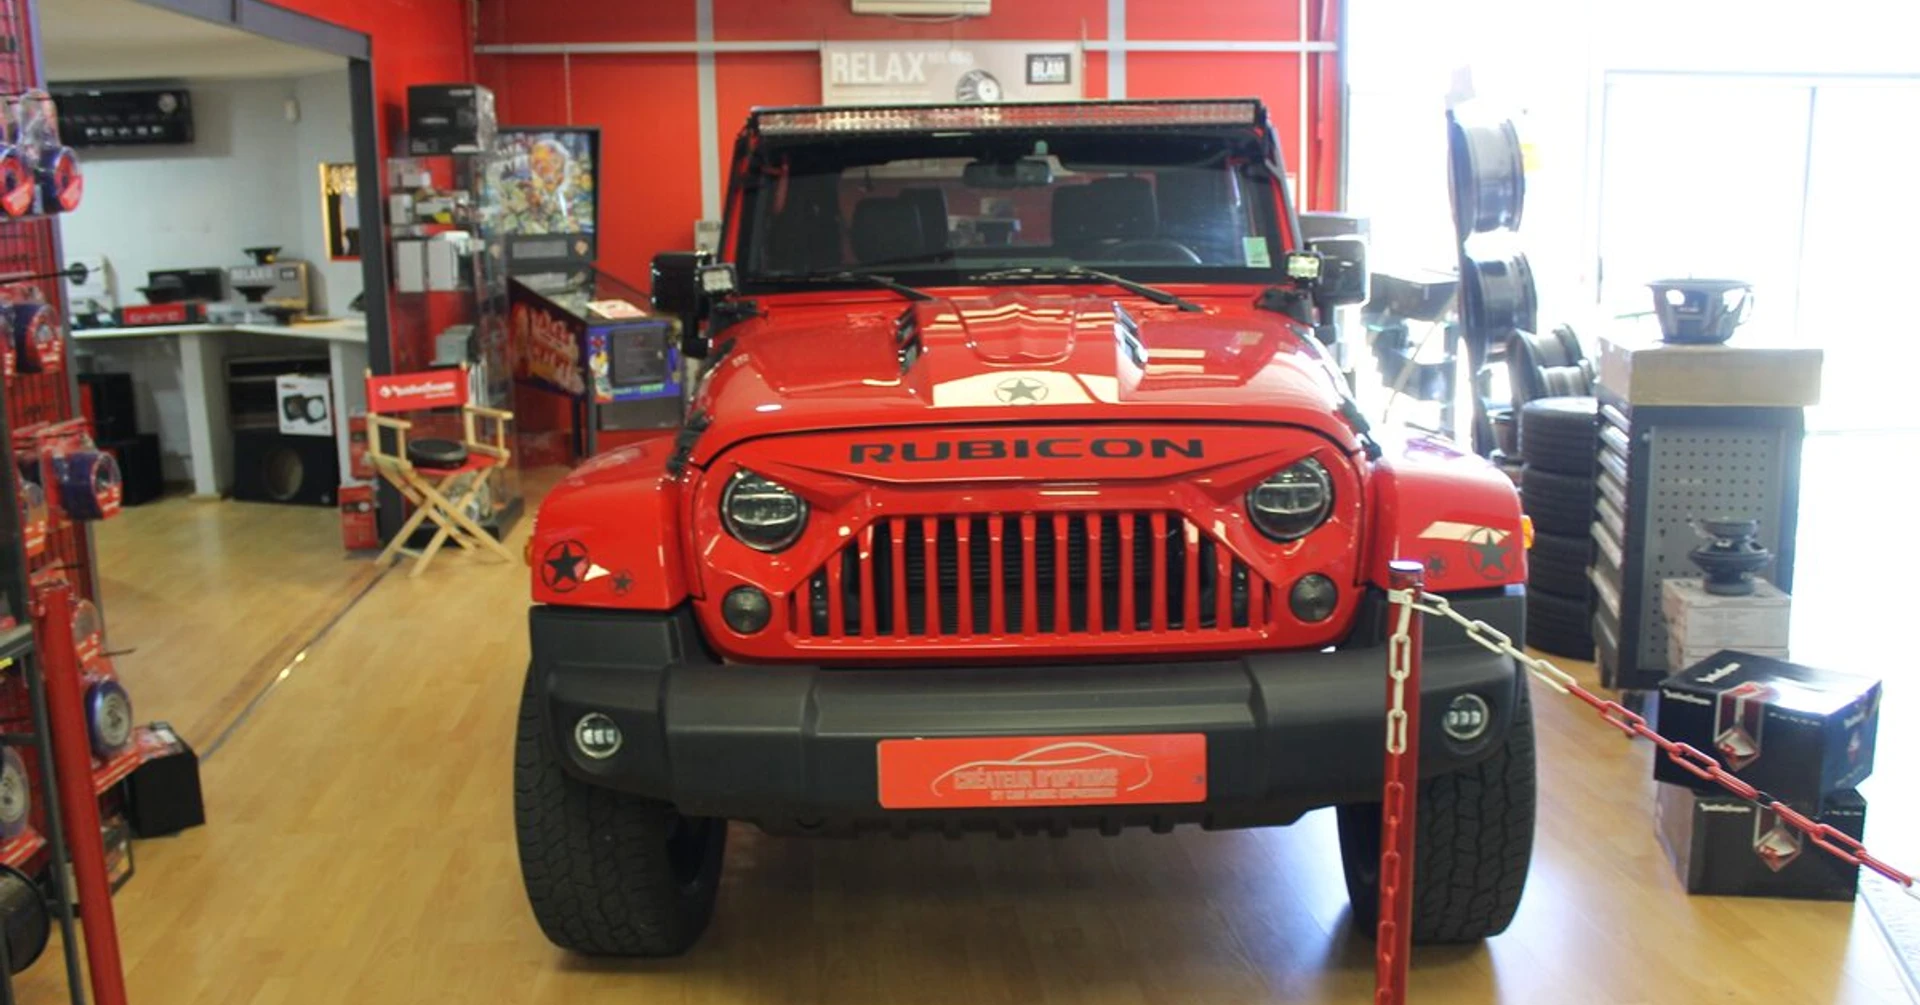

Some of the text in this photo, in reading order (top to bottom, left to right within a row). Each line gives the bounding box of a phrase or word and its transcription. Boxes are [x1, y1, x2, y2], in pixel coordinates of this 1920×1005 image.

[832, 52, 926, 83] RELAX
[1032, 61, 1065, 76] BLAM
[850, 438, 1204, 464] RUBICON
